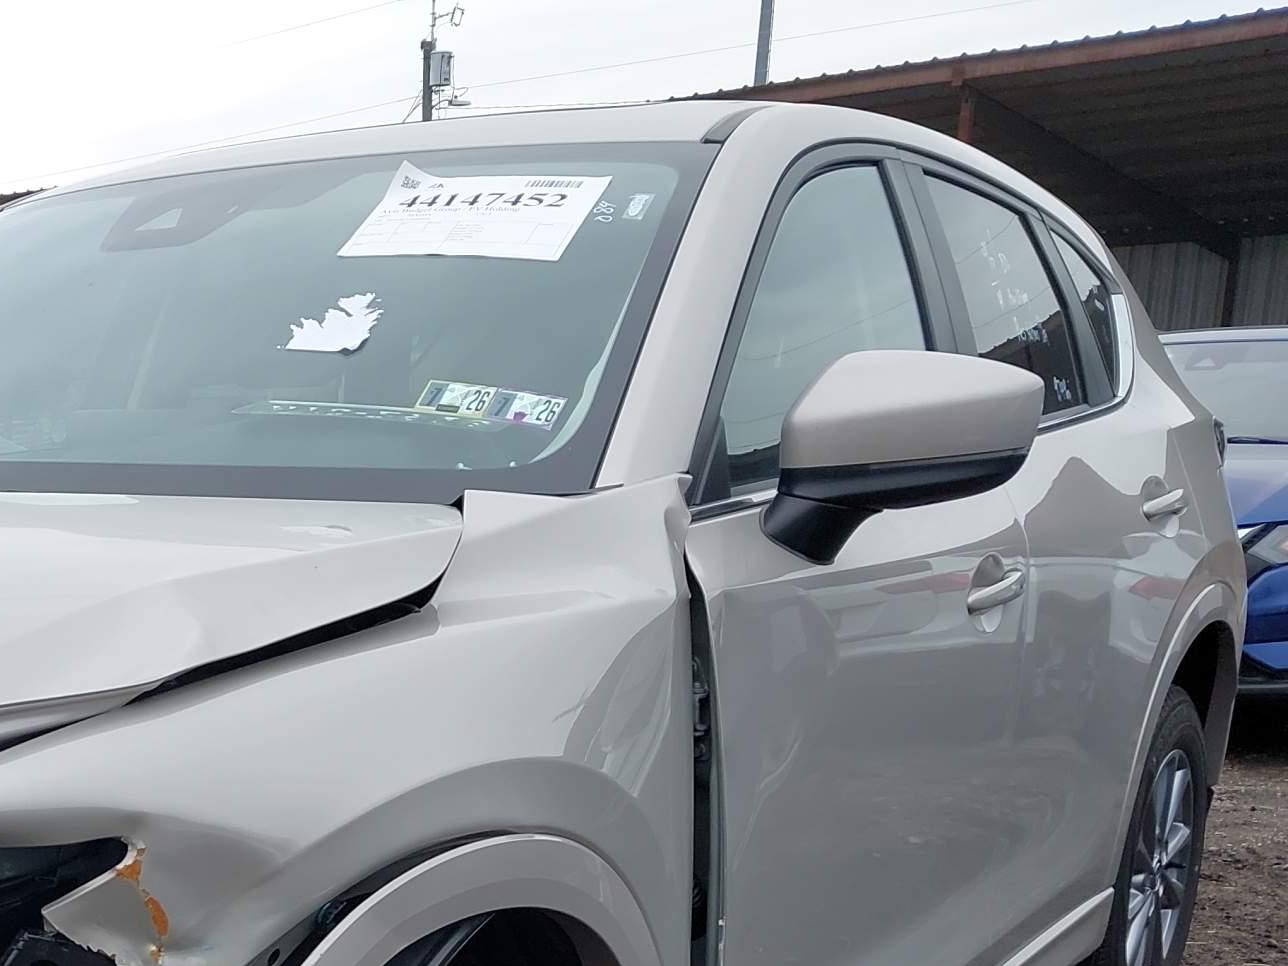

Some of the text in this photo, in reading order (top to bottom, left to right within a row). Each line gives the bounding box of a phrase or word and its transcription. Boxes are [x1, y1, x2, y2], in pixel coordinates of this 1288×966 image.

[399, 192, 569, 208] 44147452
[465, 389, 491, 412] 26
[535, 400, 562, 423] 26
